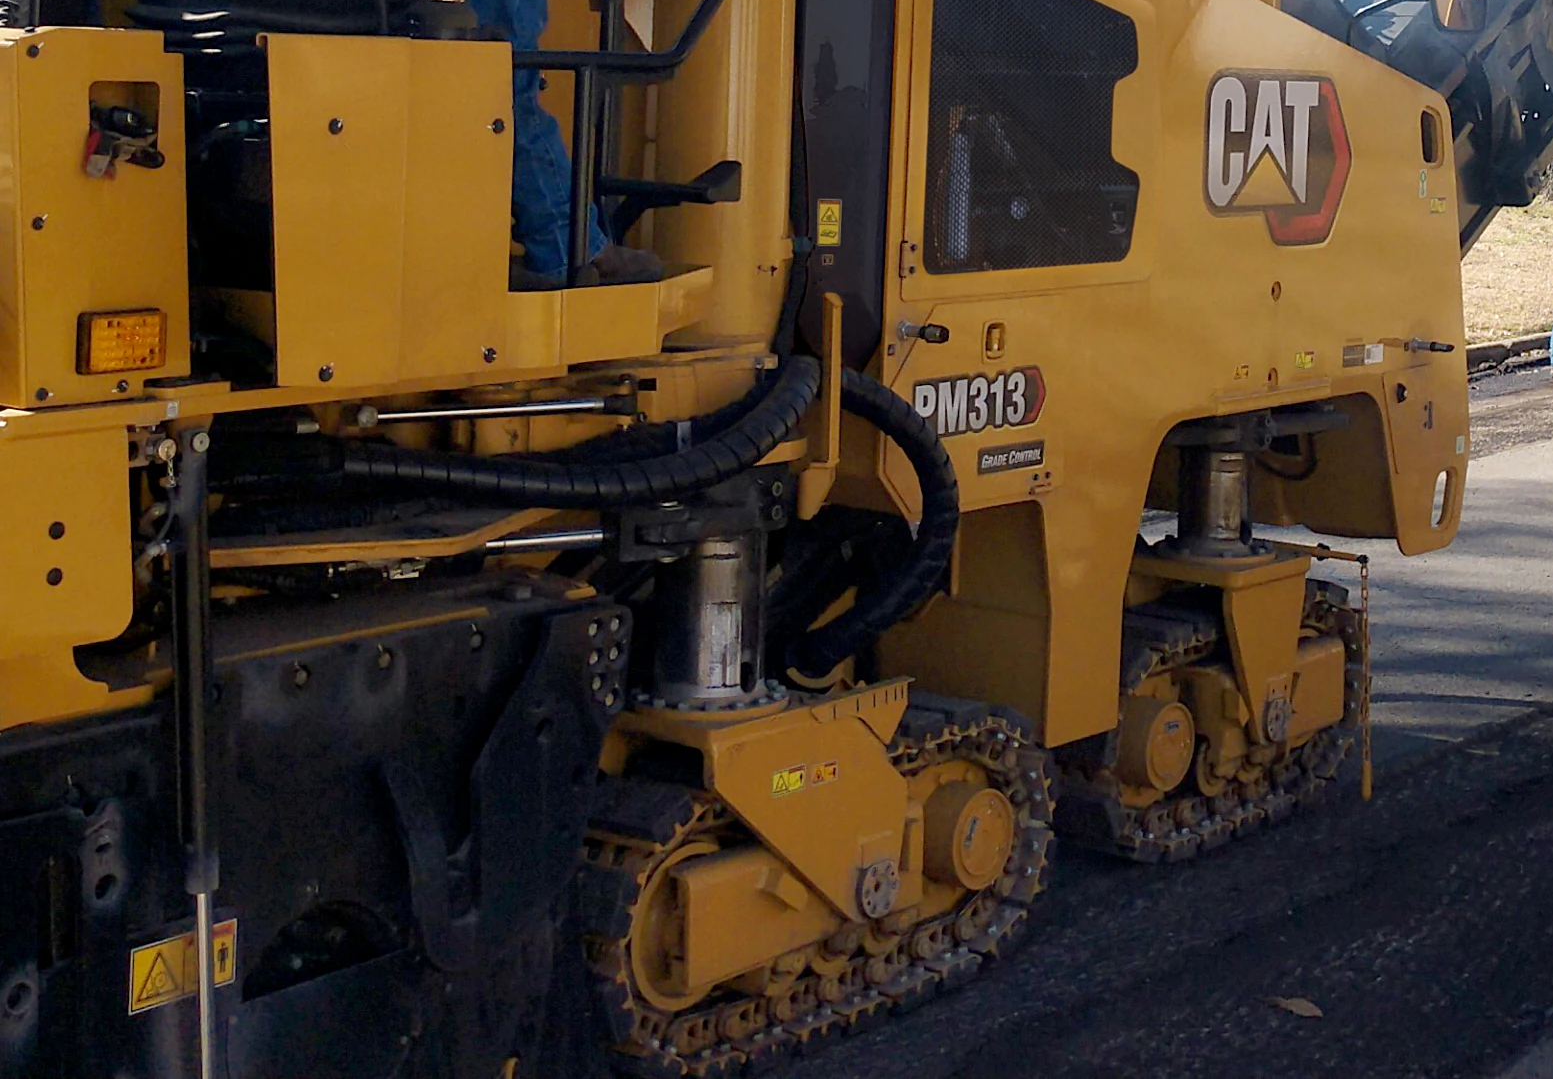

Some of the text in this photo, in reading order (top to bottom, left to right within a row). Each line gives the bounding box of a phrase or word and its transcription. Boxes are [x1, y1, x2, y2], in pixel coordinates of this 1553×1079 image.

[1208, 77, 1319, 207] CAT
[915, 371, 1026, 435] PM313
[982, 448, 1041, 469] GRADE CONTROL
